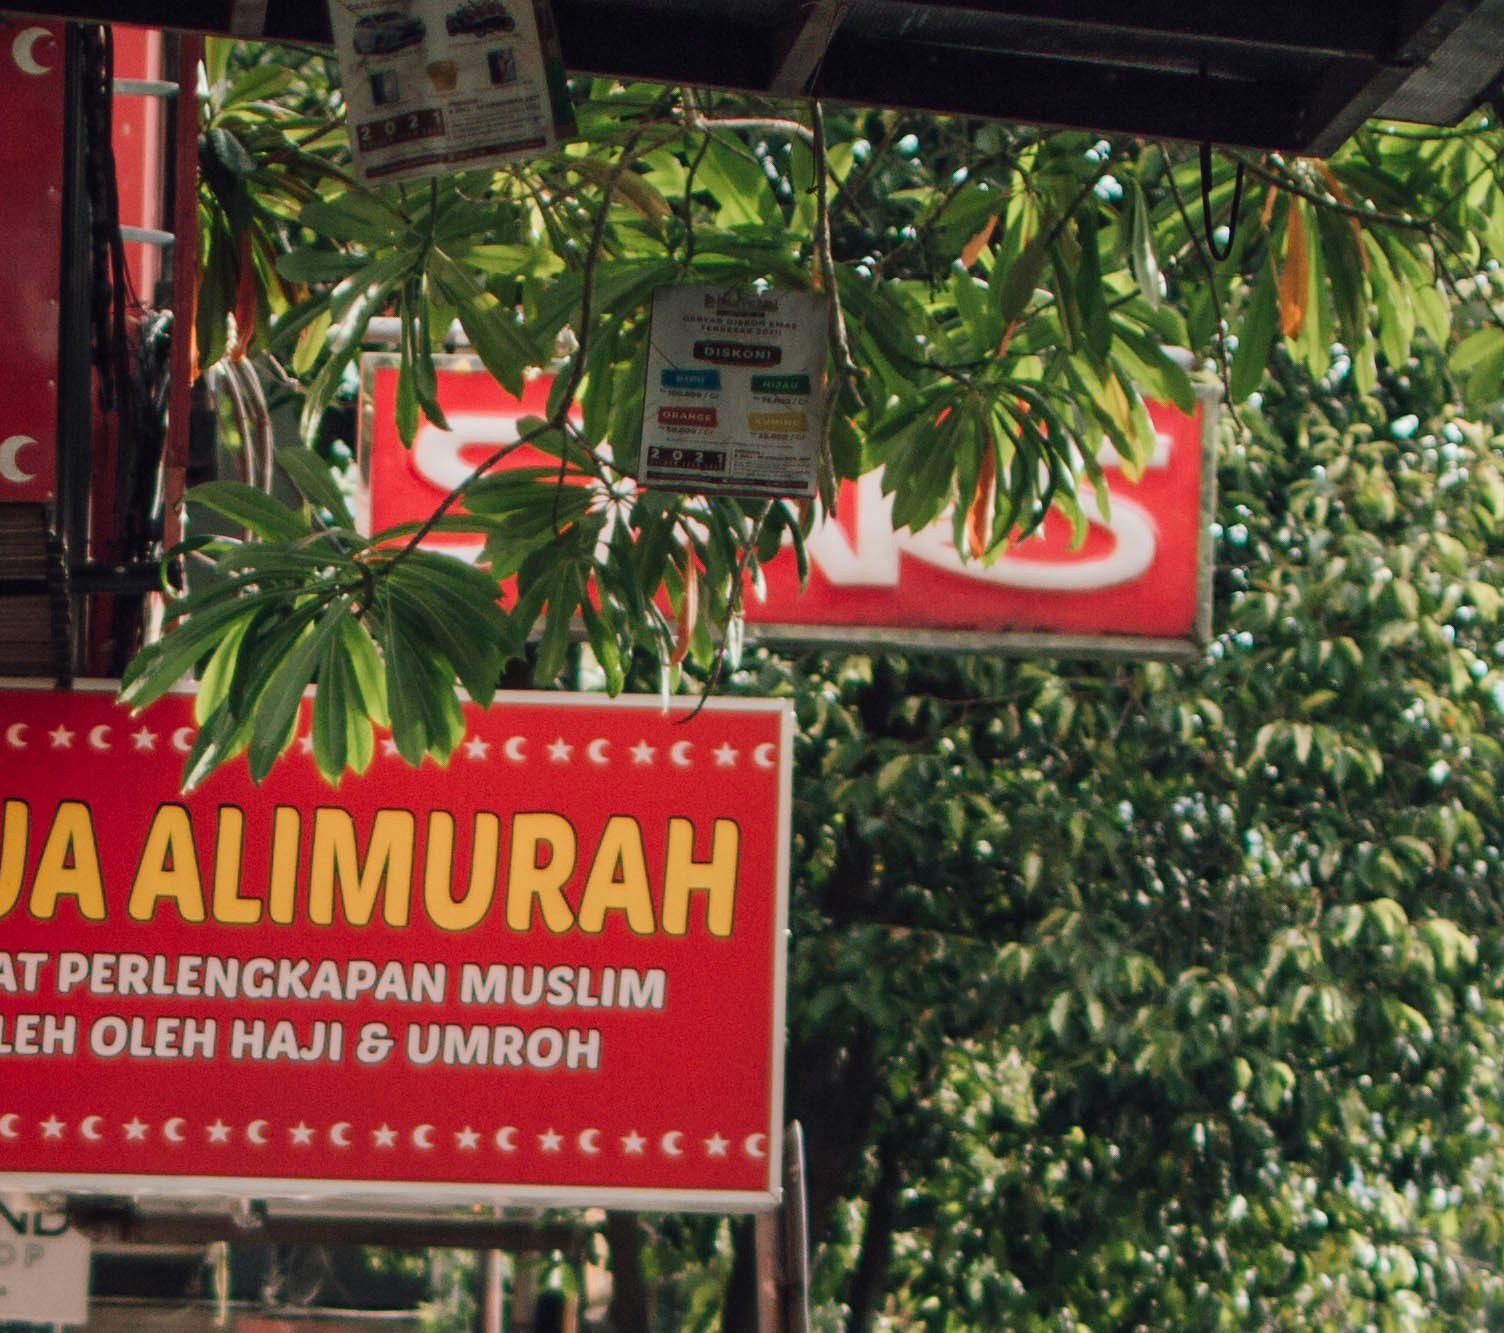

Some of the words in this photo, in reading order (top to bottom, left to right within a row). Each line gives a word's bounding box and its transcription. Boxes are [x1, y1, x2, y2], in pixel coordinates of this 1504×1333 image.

[704, 347, 771, 359] DISKON!
[125, 802, 743, 942] ALIMURAH
[55, 954, 447, 1004] PERLENGKAPAN
[458, 960, 667, 1012] MUSLIM
[90, 1015, 216, 1062] OLEH
[230, 1019, 342, 1064] HAJI
[357, 1023, 394, 1066] &
[406, 1021, 602, 1072] UMROH
